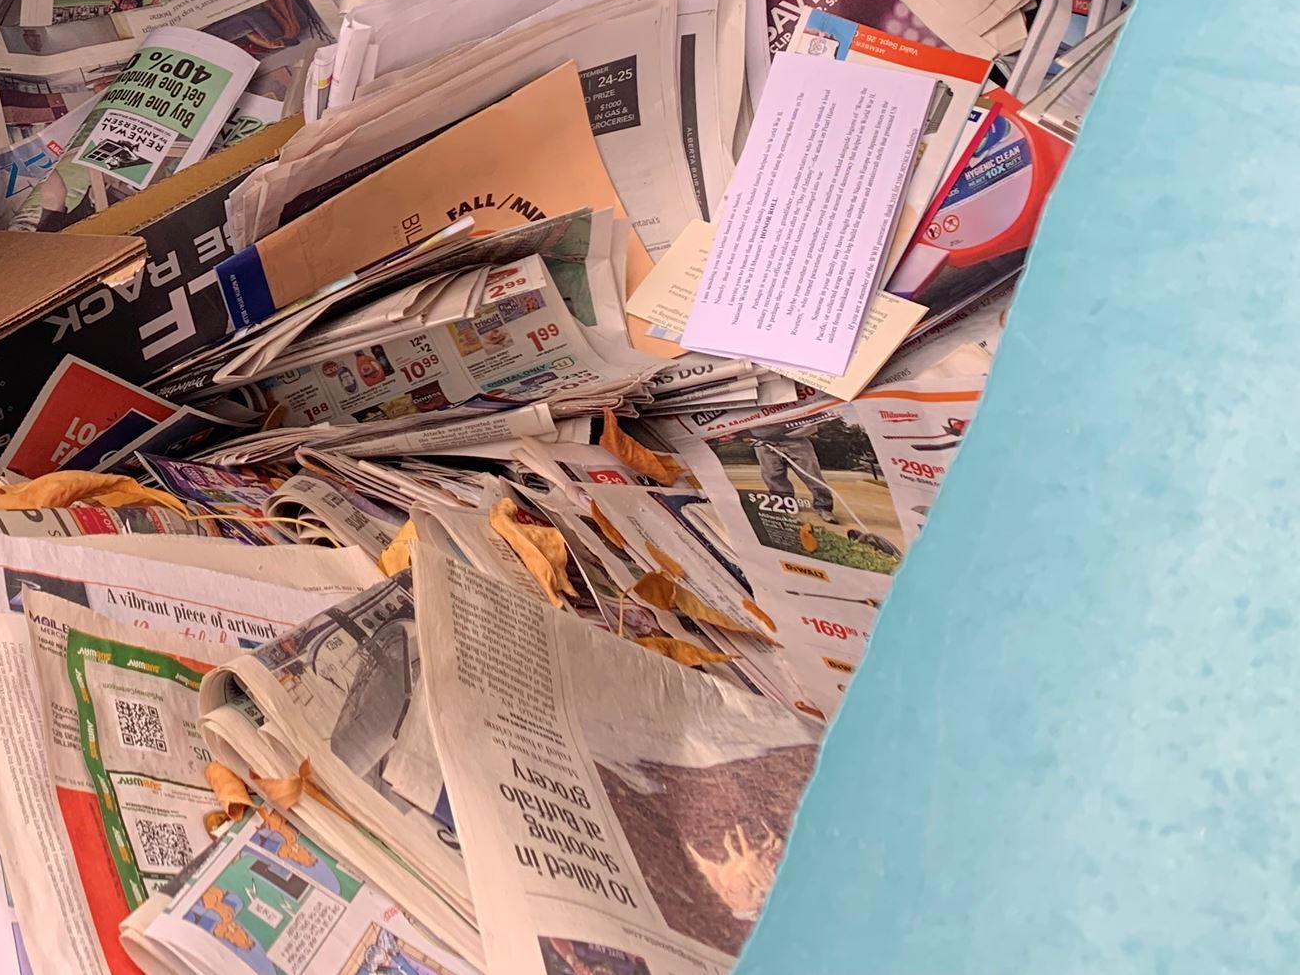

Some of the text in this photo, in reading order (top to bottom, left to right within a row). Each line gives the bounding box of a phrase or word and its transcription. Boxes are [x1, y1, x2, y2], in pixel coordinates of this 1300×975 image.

[149, 52, 212, 85] 40%
[598, 68, 633, 88] 24-25
[145, 95, 171, 117] One
[159, 76, 206, 108] Get One
[593, 89, 616, 102] PRIZE
[600, 99, 622, 111] $1000
[104, 117, 162, 142] ANDERSEN
[169, 107, 196, 129] Buy
[594, 113, 604, 121] IN
[605, 108, 621, 120] GAS
[102, 123, 165, 152] RENEWAL
[686, 126, 696, 165] ALBERTA
[964, 146, 1021, 180] HYGIENIC CLEAN
[986, 164, 1007, 180] 10X
[1005, 156, 1022, 168] DUTY
[760, 215, 772, 239] HONOR
[44, 250, 182, 344] RACK
[107, 588, 277, 638] A vibrant piece of artwork
[512, 758, 591, 809] grocery
[501, 783, 605, 843] at Buffalo
[529, 814, 619, 875] shooting
[518, 845, 638, 909] 10 killed in
